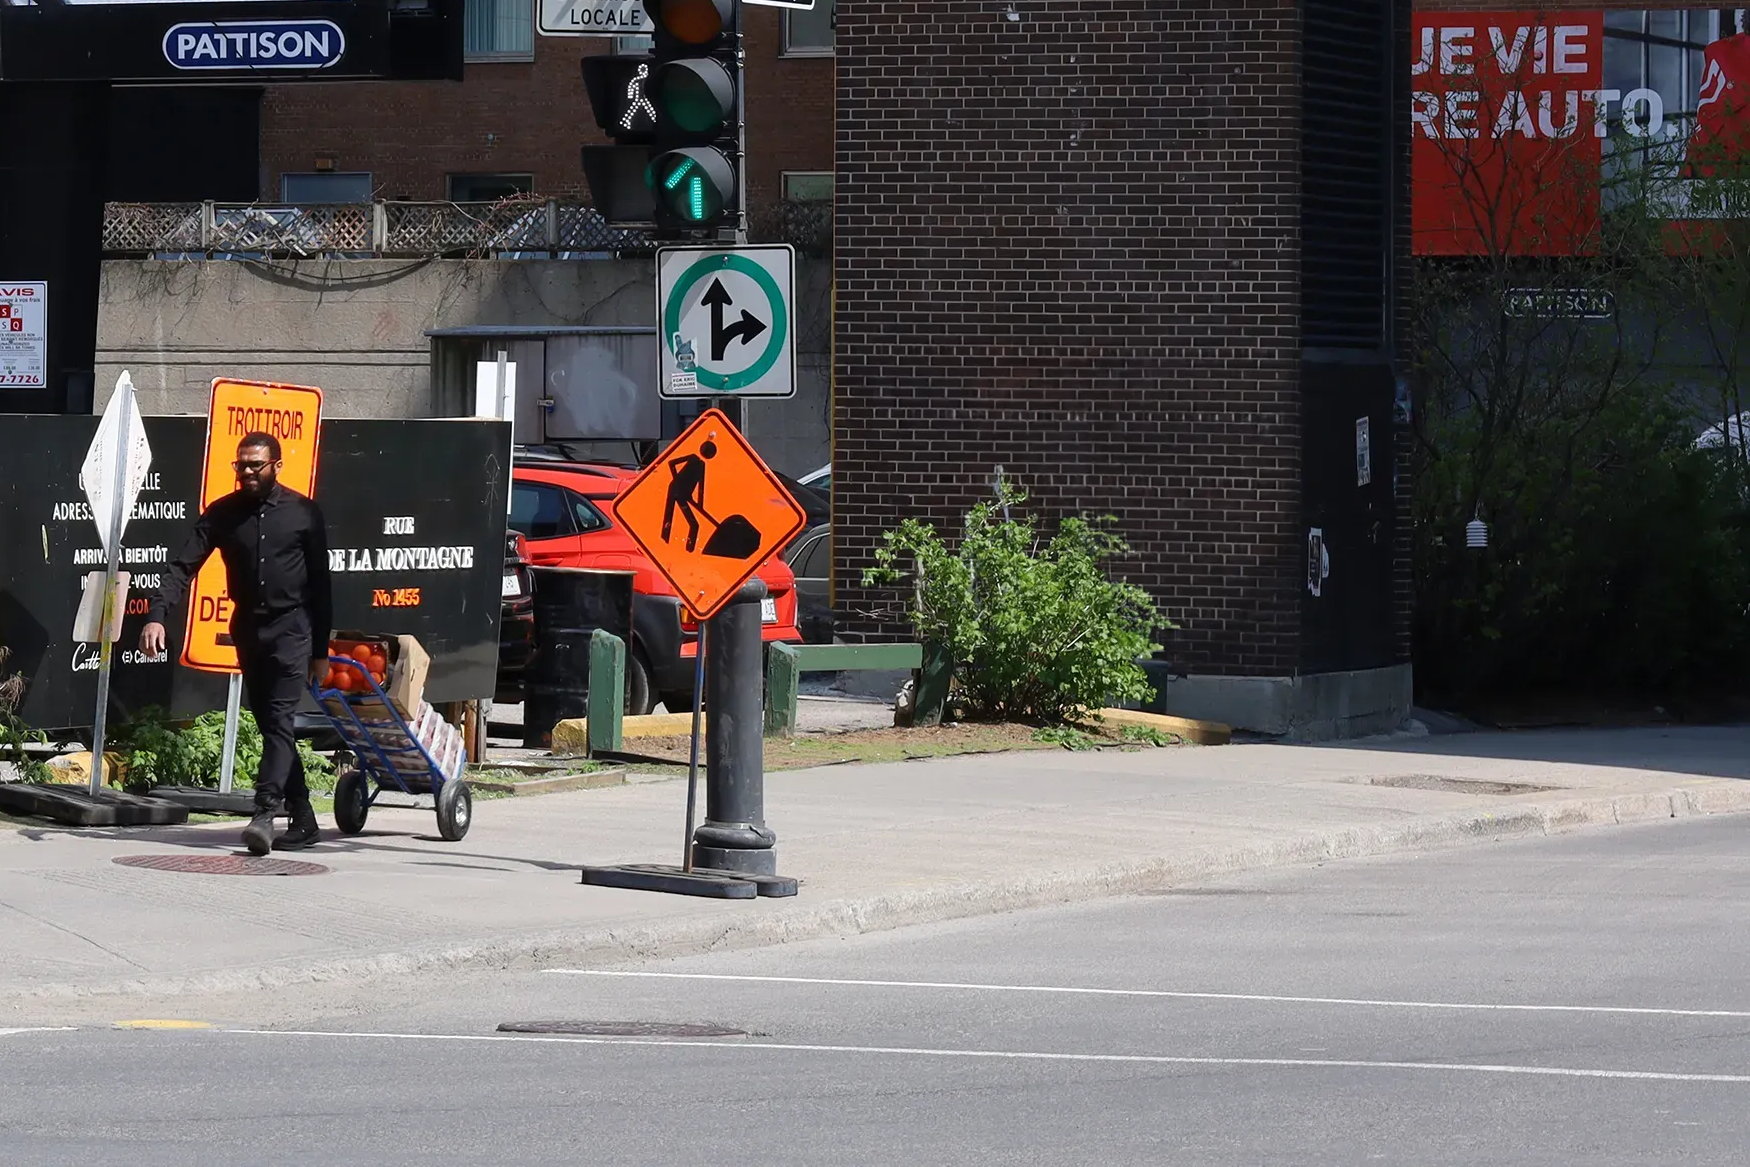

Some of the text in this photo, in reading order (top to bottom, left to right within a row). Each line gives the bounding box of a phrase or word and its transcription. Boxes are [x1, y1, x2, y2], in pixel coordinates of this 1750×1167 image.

[570, 8, 641, 26] LOCALE
[176, 31, 332, 61] PATTISON
[1487, 24, 1589, 74] VIE
[1510, 294, 1607, 312] PAISON
[52, 502, 94, 521] ADRES
[382, 516, 415, 535] RUE
[73, 545, 169, 565] ARRIVA BIENTÔT
[347, 548, 373, 572] LA
[375, 546, 474, 571] MONTAGNE
[371, 587, 421, 607] No 1455
